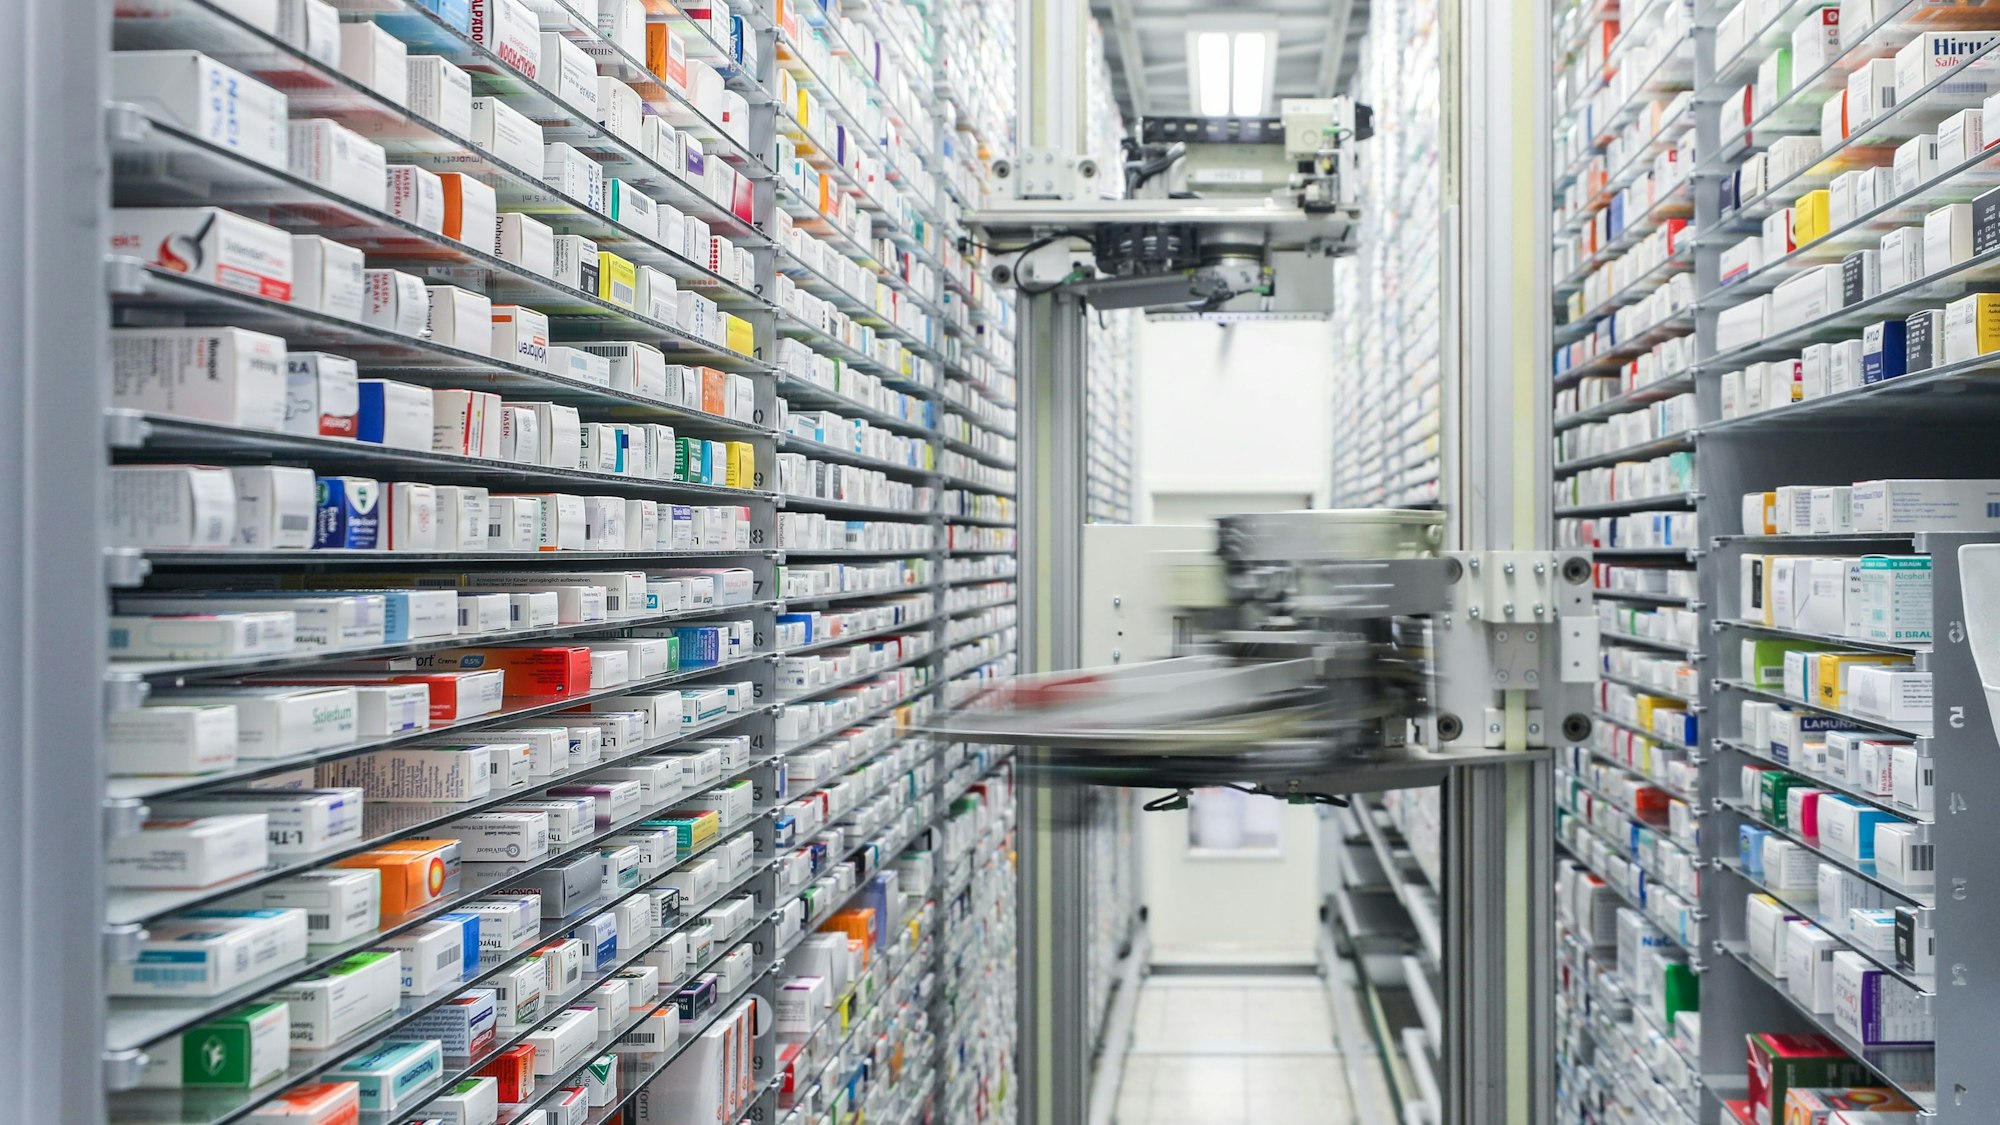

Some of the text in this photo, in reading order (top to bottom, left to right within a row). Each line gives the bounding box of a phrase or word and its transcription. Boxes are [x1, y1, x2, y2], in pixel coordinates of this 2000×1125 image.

[1866, 328, 1880, 343] HYLO
[518, 340, 547, 364] Voltaren
[753, 472, 764, 487] 9
[1895, 572, 1925, 580] Alcohol
[753, 580, 763, 595] 7
[753, 632, 764, 647] 6
[753, 683, 763, 697] 5
[312, 707, 352, 726] Soledum
[1804, 720, 1857, 729] LAMUNA
[753, 786, 763, 801] 3
[753, 838, 763, 852] 2
[753, 1056, 763, 1070] 9
[753, 1107, 764, 1121] 8
